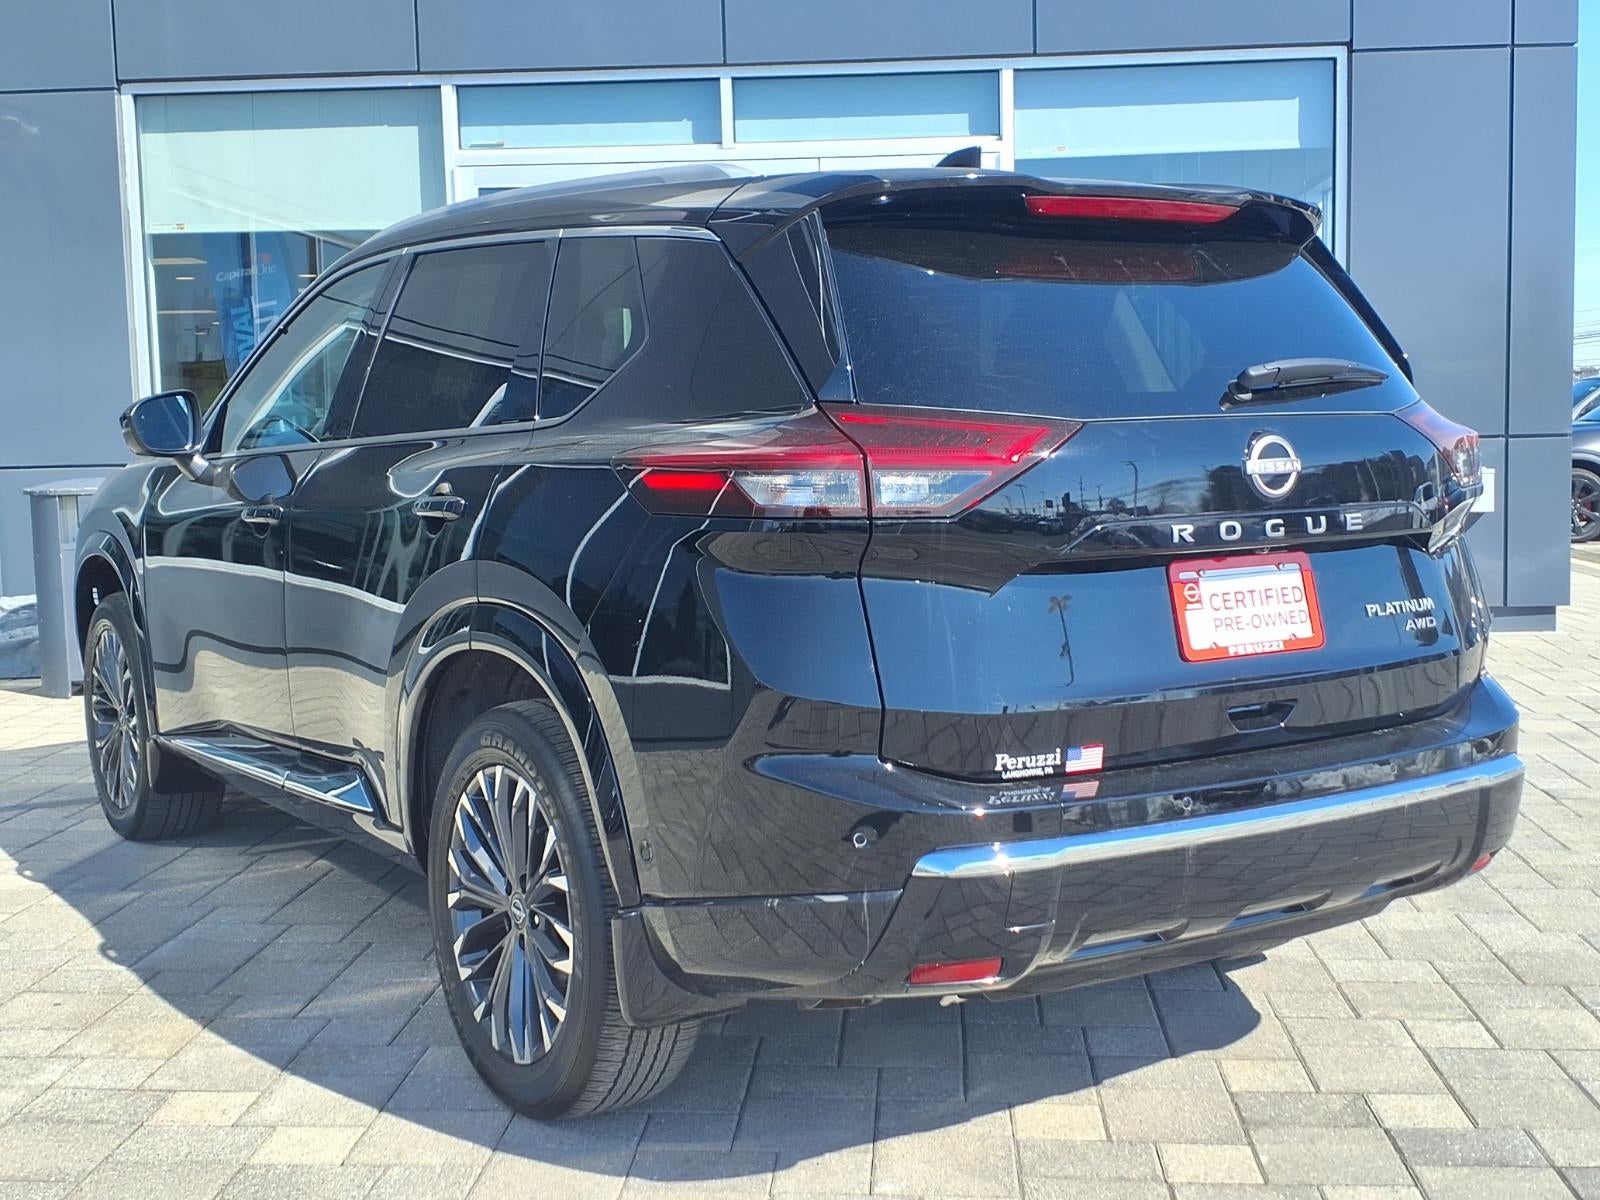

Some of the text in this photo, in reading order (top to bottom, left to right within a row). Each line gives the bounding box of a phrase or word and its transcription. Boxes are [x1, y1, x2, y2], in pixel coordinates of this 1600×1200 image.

[1247, 458, 1301, 474] NISSAN
[1172, 513, 1363, 544] ROGUE
[1209, 585, 1304, 612] CERTIFIED
[1365, 597, 1434, 616] PLATINUM
[1213, 609, 1308, 632] PRE-OWNED
[1405, 616, 1436, 631] AWD
[994, 748, 1062, 772] Peruzzi
